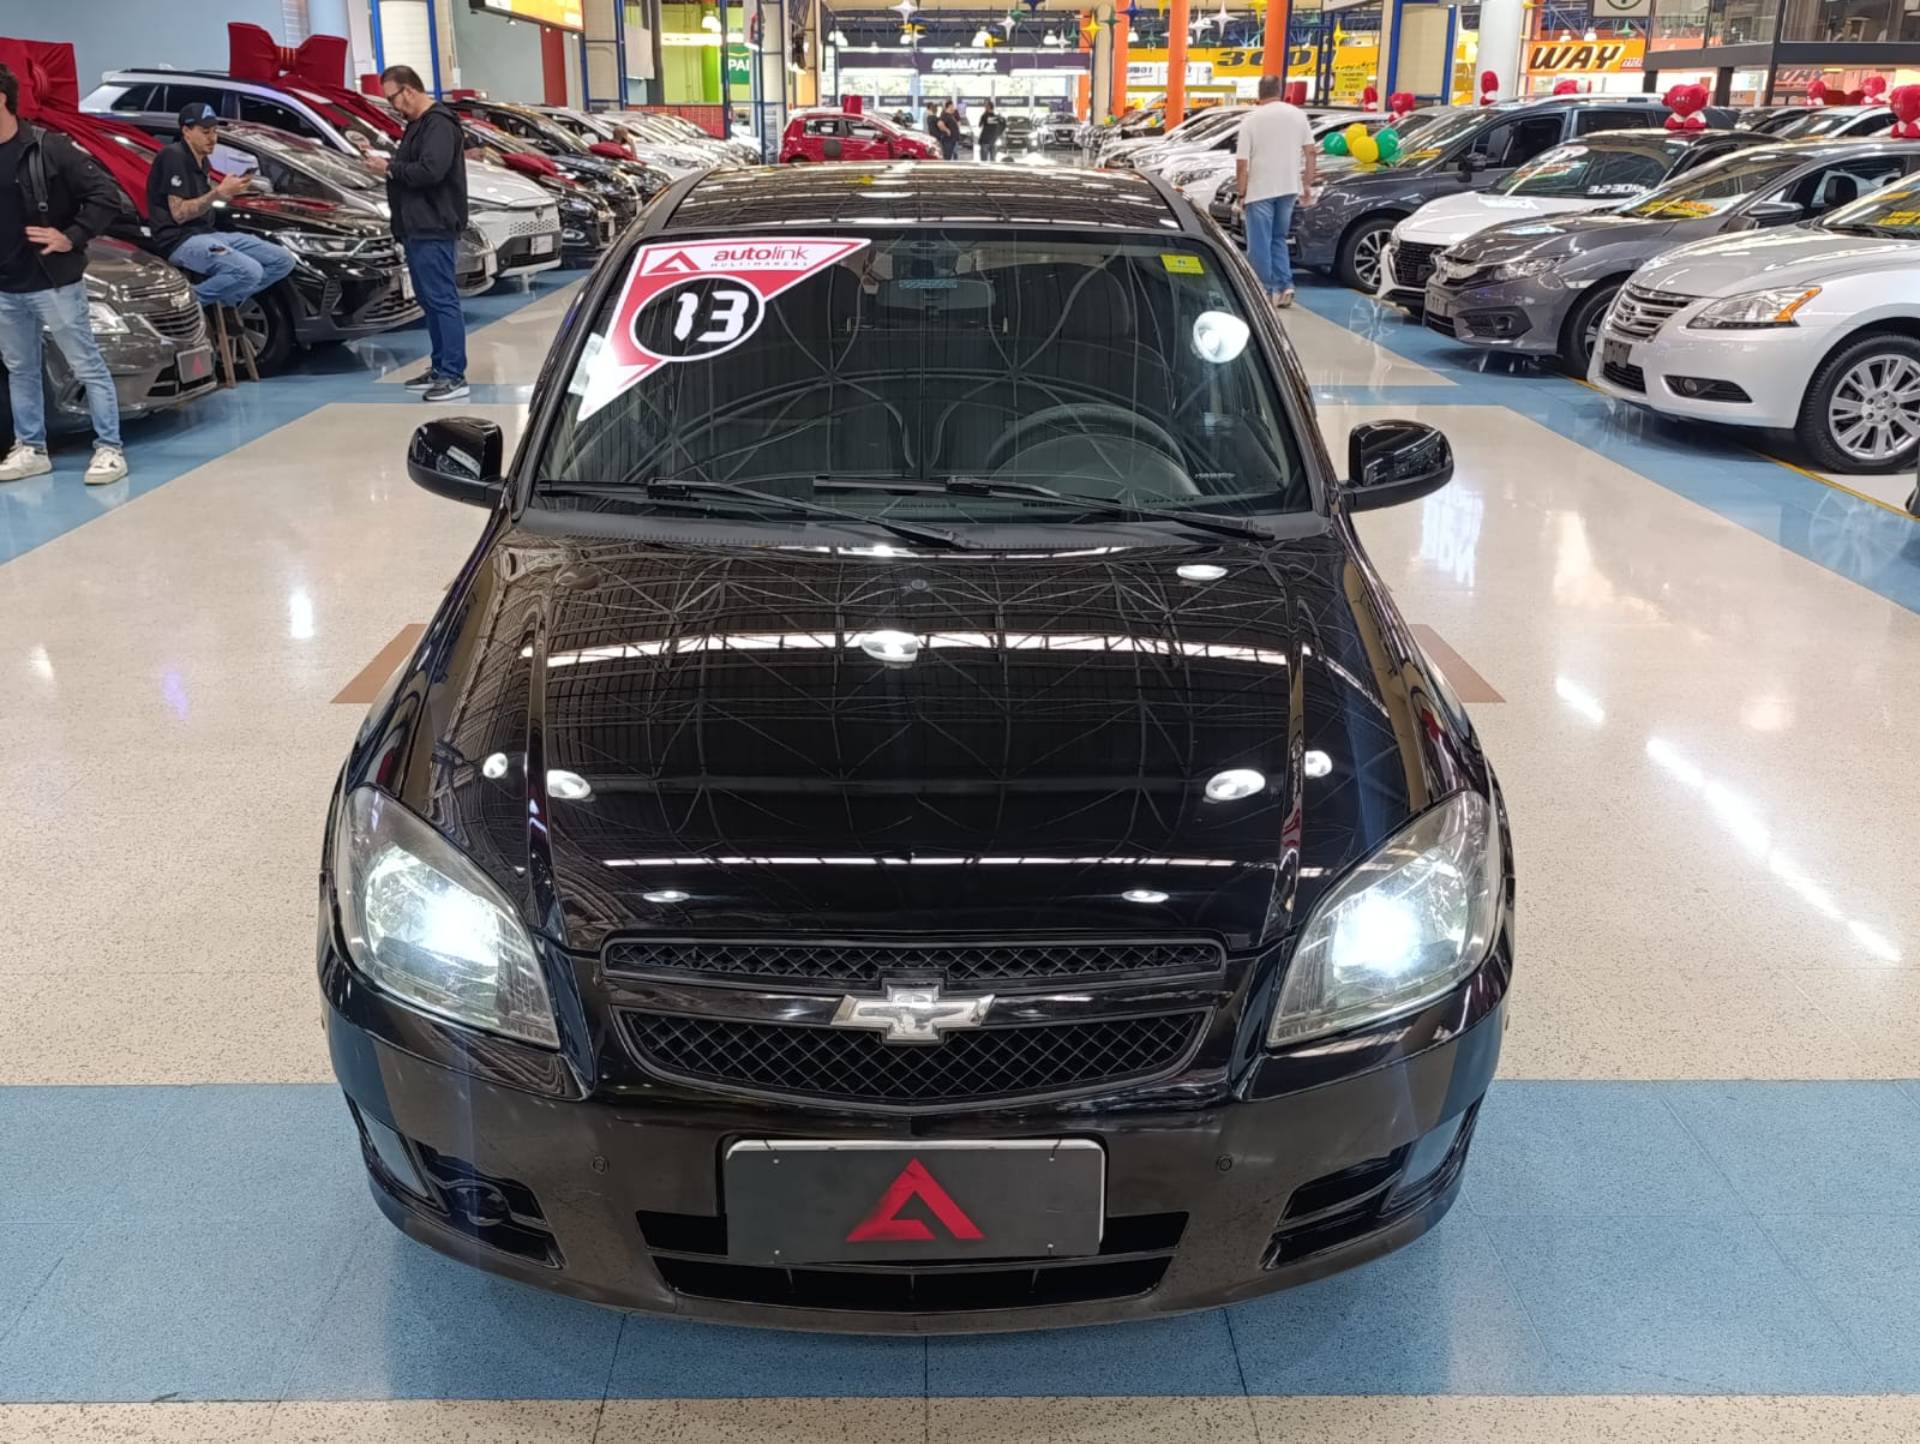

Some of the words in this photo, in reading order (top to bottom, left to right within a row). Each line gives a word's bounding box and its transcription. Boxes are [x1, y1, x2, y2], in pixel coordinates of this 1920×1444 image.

[1529, 46, 1623, 70] WAY
[713, 245, 809, 262] autolink
[673, 289, 750, 342] 13
